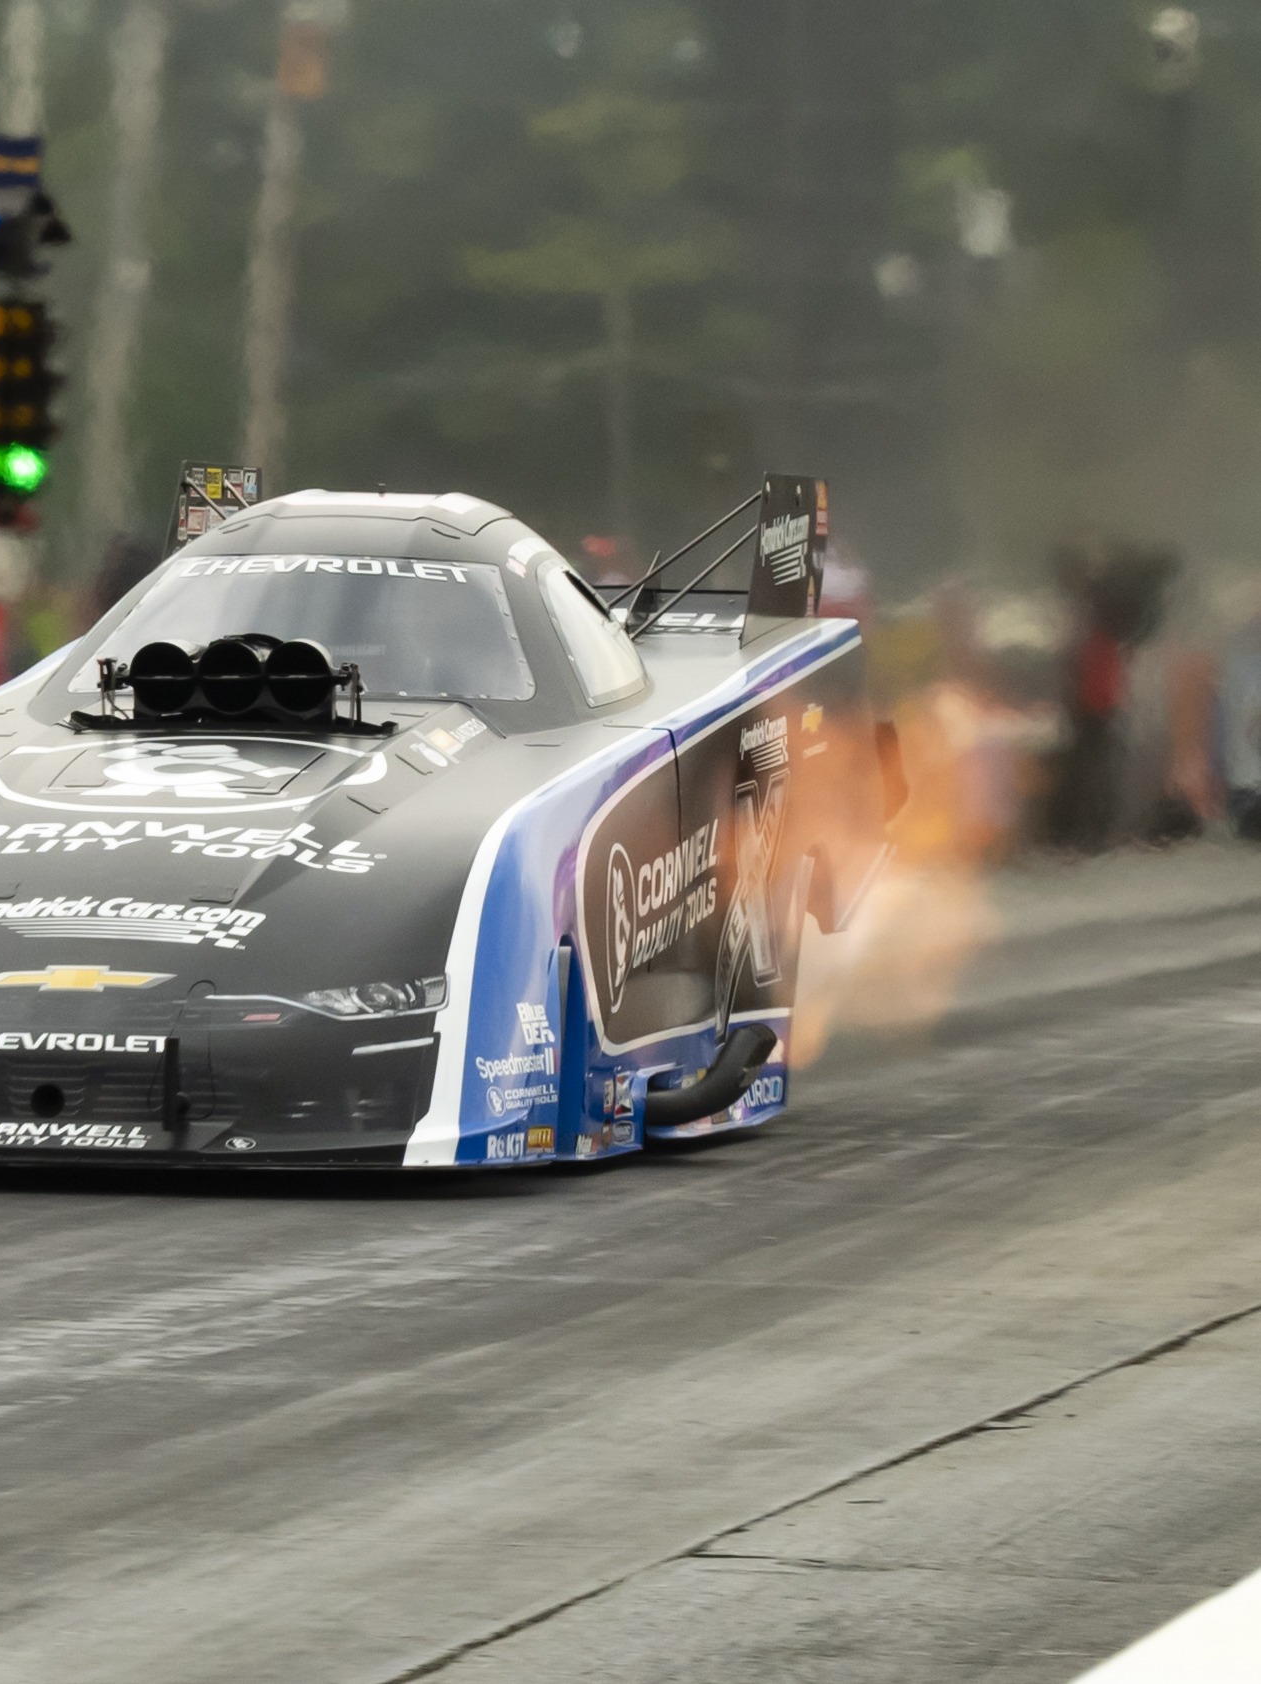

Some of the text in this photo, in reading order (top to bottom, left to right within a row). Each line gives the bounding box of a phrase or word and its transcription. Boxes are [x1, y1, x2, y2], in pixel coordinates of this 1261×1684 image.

[180, 558, 470, 583] CHEVROLET
[171, 840, 375, 874] TOOLS
[638, 818, 718, 918] CORNWELL
[633, 902, 685, 969] QUALITY
[685, 877, 717, 934] TOOLS
[516, 1002, 547, 1022] Blue
[523, 1021, 551, 1046] DEF
[475, 1053, 545, 1083] Speedmaster
[505, 1084, 556, 1099] CORNWELL
[505, 1095, 558, 1110] QUALITY TOOLS
[60, 1136, 149, 1149] TOOLS
